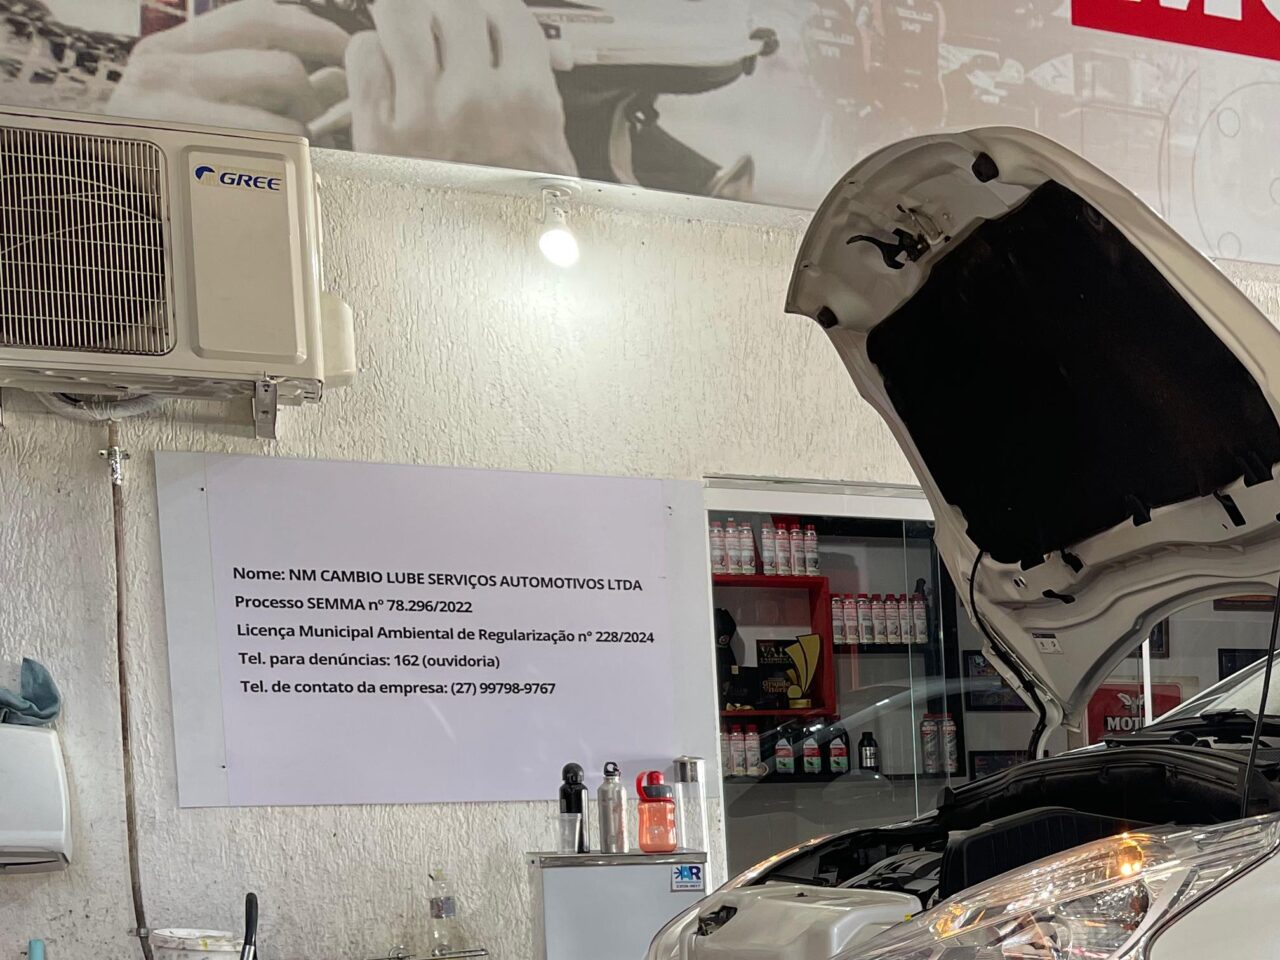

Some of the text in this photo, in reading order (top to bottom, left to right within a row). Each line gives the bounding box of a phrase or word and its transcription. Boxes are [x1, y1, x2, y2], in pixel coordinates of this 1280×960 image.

[219, 172, 282, 191] GREE
[233, 566, 643, 591] Nome: NM CAMBIO LUBE SERVIÇOS AUTOMOTIVOS LTDA
[235, 595, 473, 613] Processo SEMMA nº 78.296/2022
[237, 624, 296, 640] Licença
[299, 624, 374, 641] Municipal
[377, 626, 454, 640] Ambiental
[457, 628, 475, 640] de
[478, 628, 575, 645] Regularização
[595, 631, 655, 643] 228/2024
[238, 652, 501, 669] Tel. para denúncias: 162 (ouvidoria)
[240, 680, 556, 697] Tel. de contato da empresa: (27) 99798-9767
[1106, 716, 1146, 731] MOT
